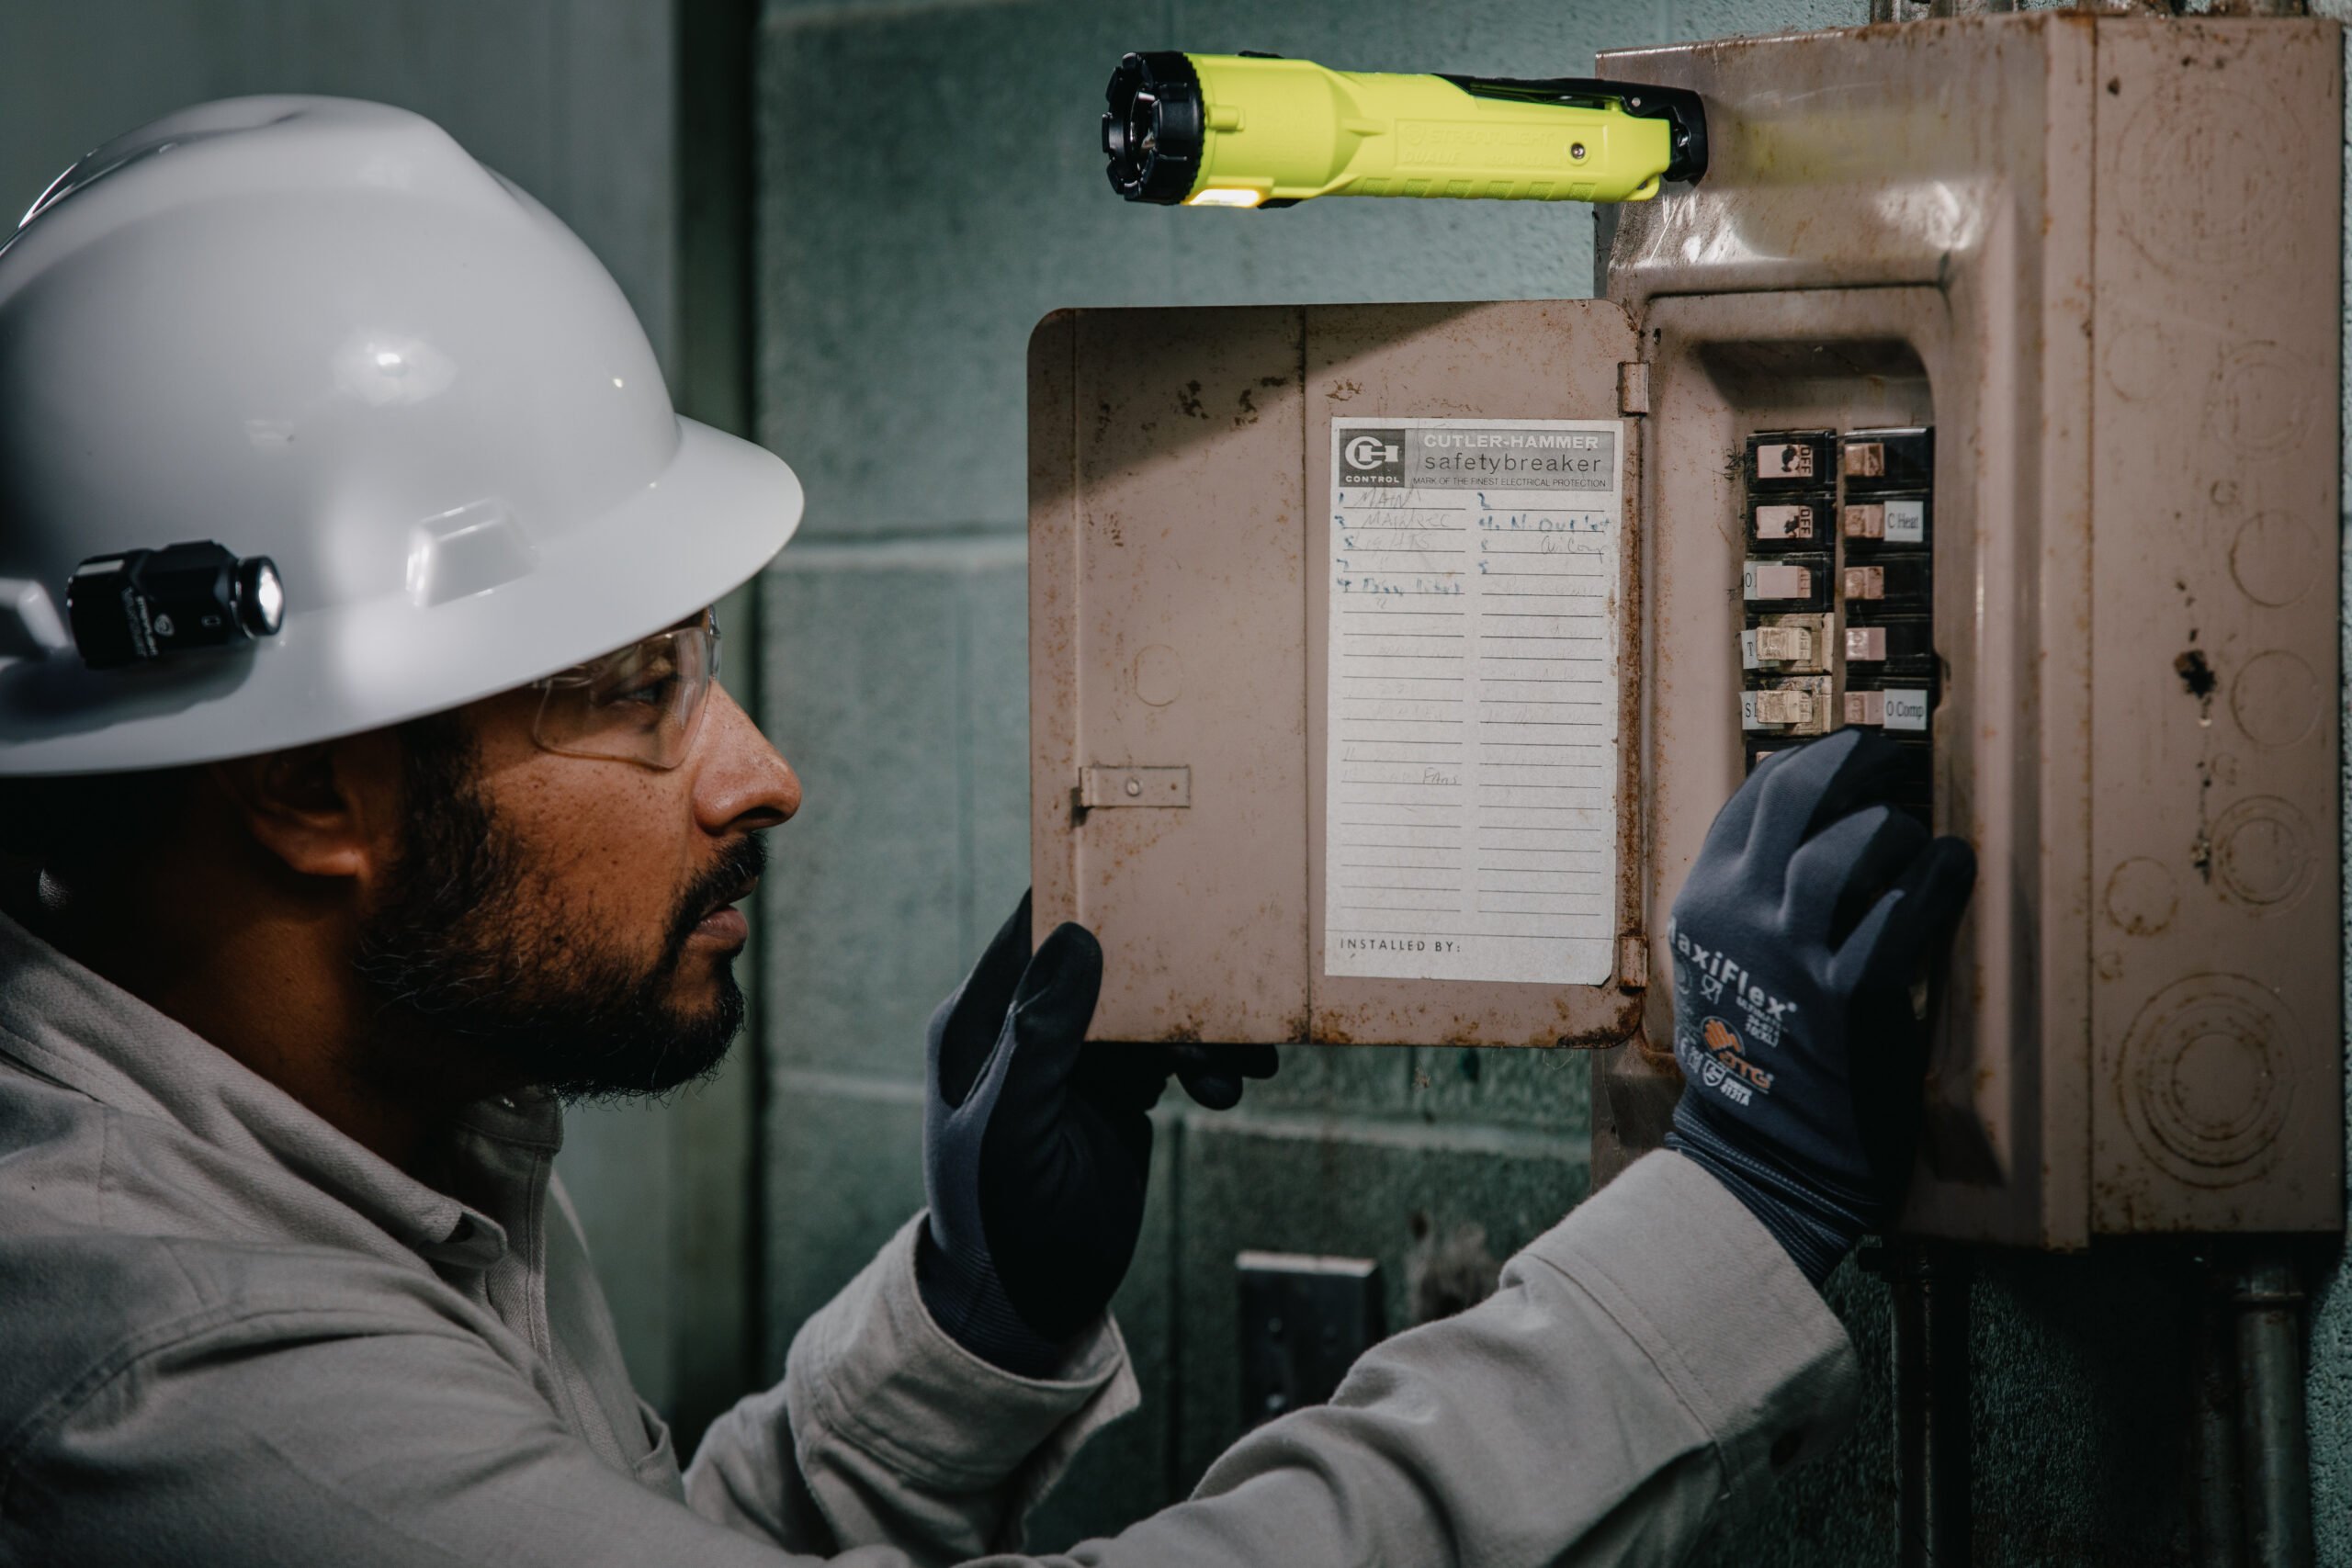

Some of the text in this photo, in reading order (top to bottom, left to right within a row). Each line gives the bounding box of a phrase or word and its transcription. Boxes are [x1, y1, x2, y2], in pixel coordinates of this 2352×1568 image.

[1424, 434, 1599, 449] CUTLER-HAMMER
[1425, 451, 1601, 475] safetybreaker
[1800, 446, 1812, 475] OFF
[1345, 475, 1400, 484] CONTROL
[1413, 477, 1607, 489] MARK OF THE FINEST ELECTRICAL PROTECTION
[1800, 508, 1812, 536] OFF
[1896, 700, 1924, 720] Comp
[1340, 938, 1461, 953] INSTALLED BY:
